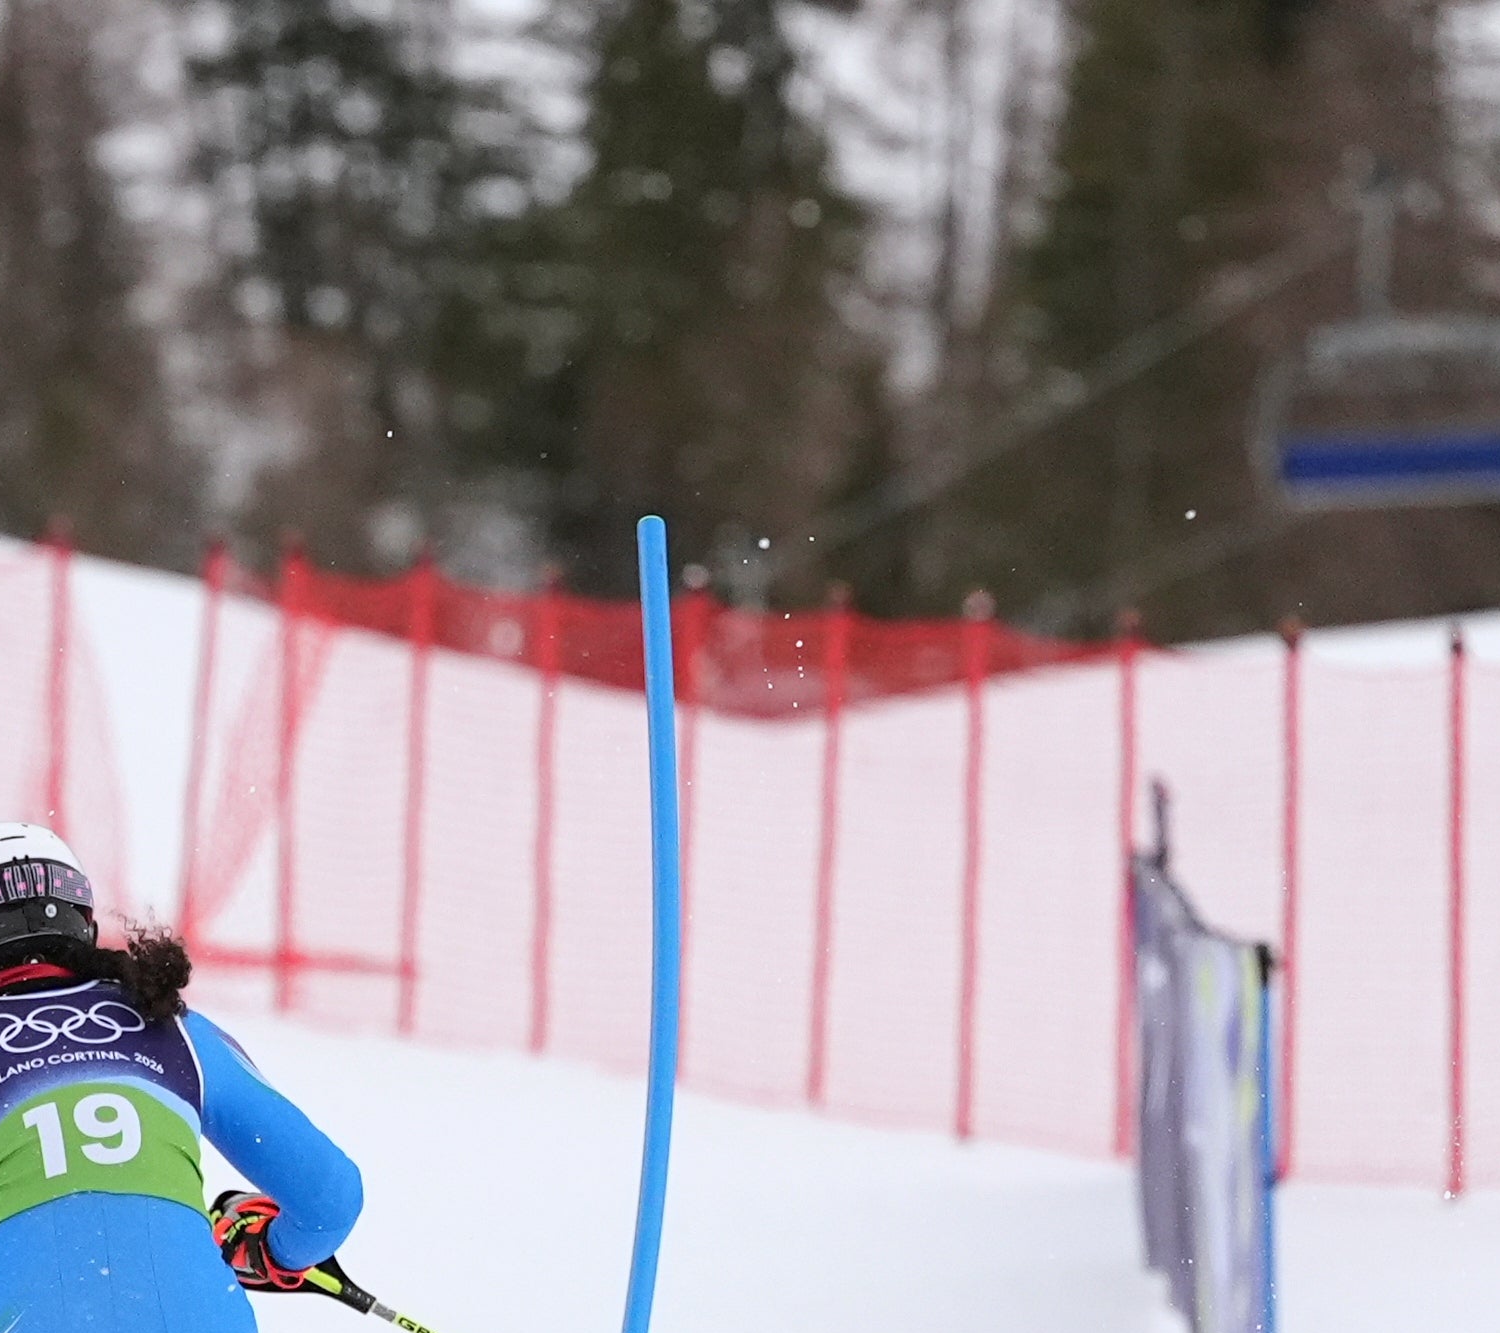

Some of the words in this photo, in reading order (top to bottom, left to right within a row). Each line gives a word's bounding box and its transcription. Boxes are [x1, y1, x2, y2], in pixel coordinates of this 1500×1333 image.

[48, 1050, 130, 1065] CORTINA
[134, 1052, 165, 1075] 2026
[22, 1092, 142, 1179] 19
